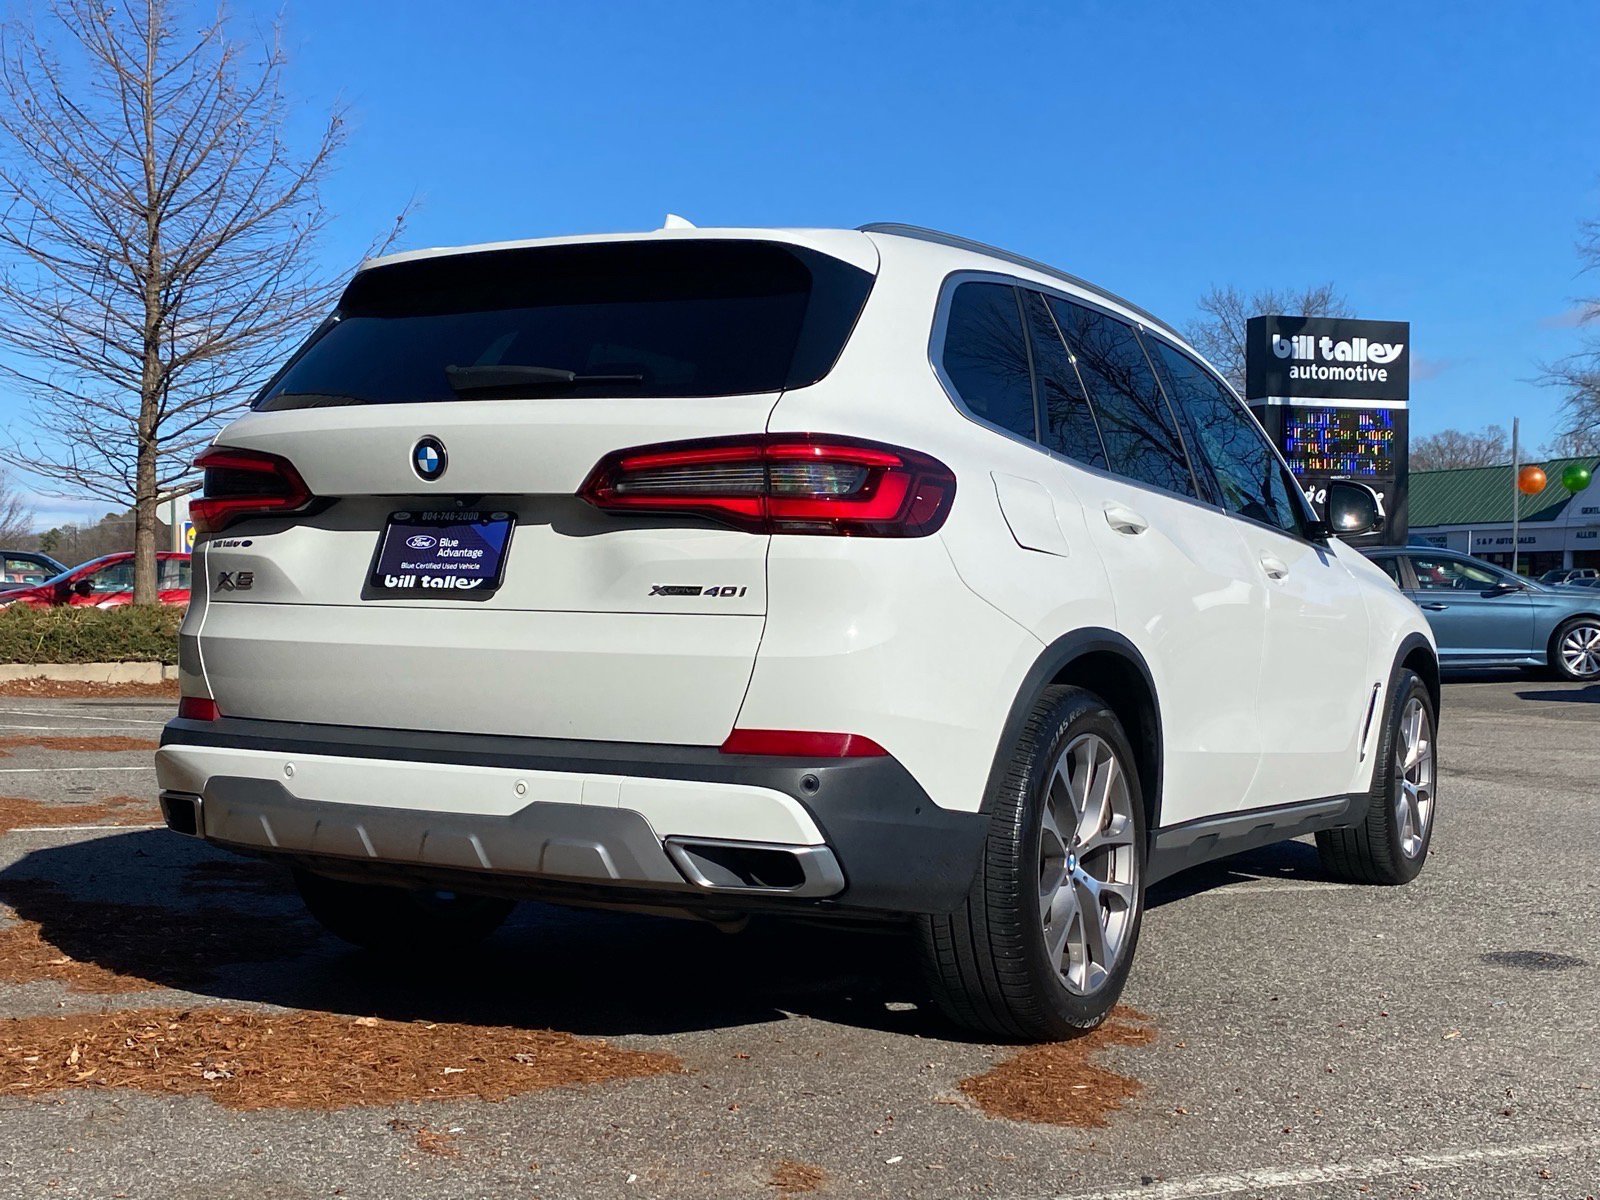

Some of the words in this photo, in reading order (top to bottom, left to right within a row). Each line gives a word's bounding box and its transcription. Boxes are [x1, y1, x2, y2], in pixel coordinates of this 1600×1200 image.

[1272, 334, 1315, 360] bill
[1319, 336, 1404, 364] talley
[1289, 364, 1388, 382] automotive
[439, 537, 459, 548] Blue
[436, 548, 484, 559] Advantage
[415, 562, 442, 570] Certified
[442, 562, 458, 570] Used
[384, 574, 416, 588] bill
[421, 575, 484, 590] talley
